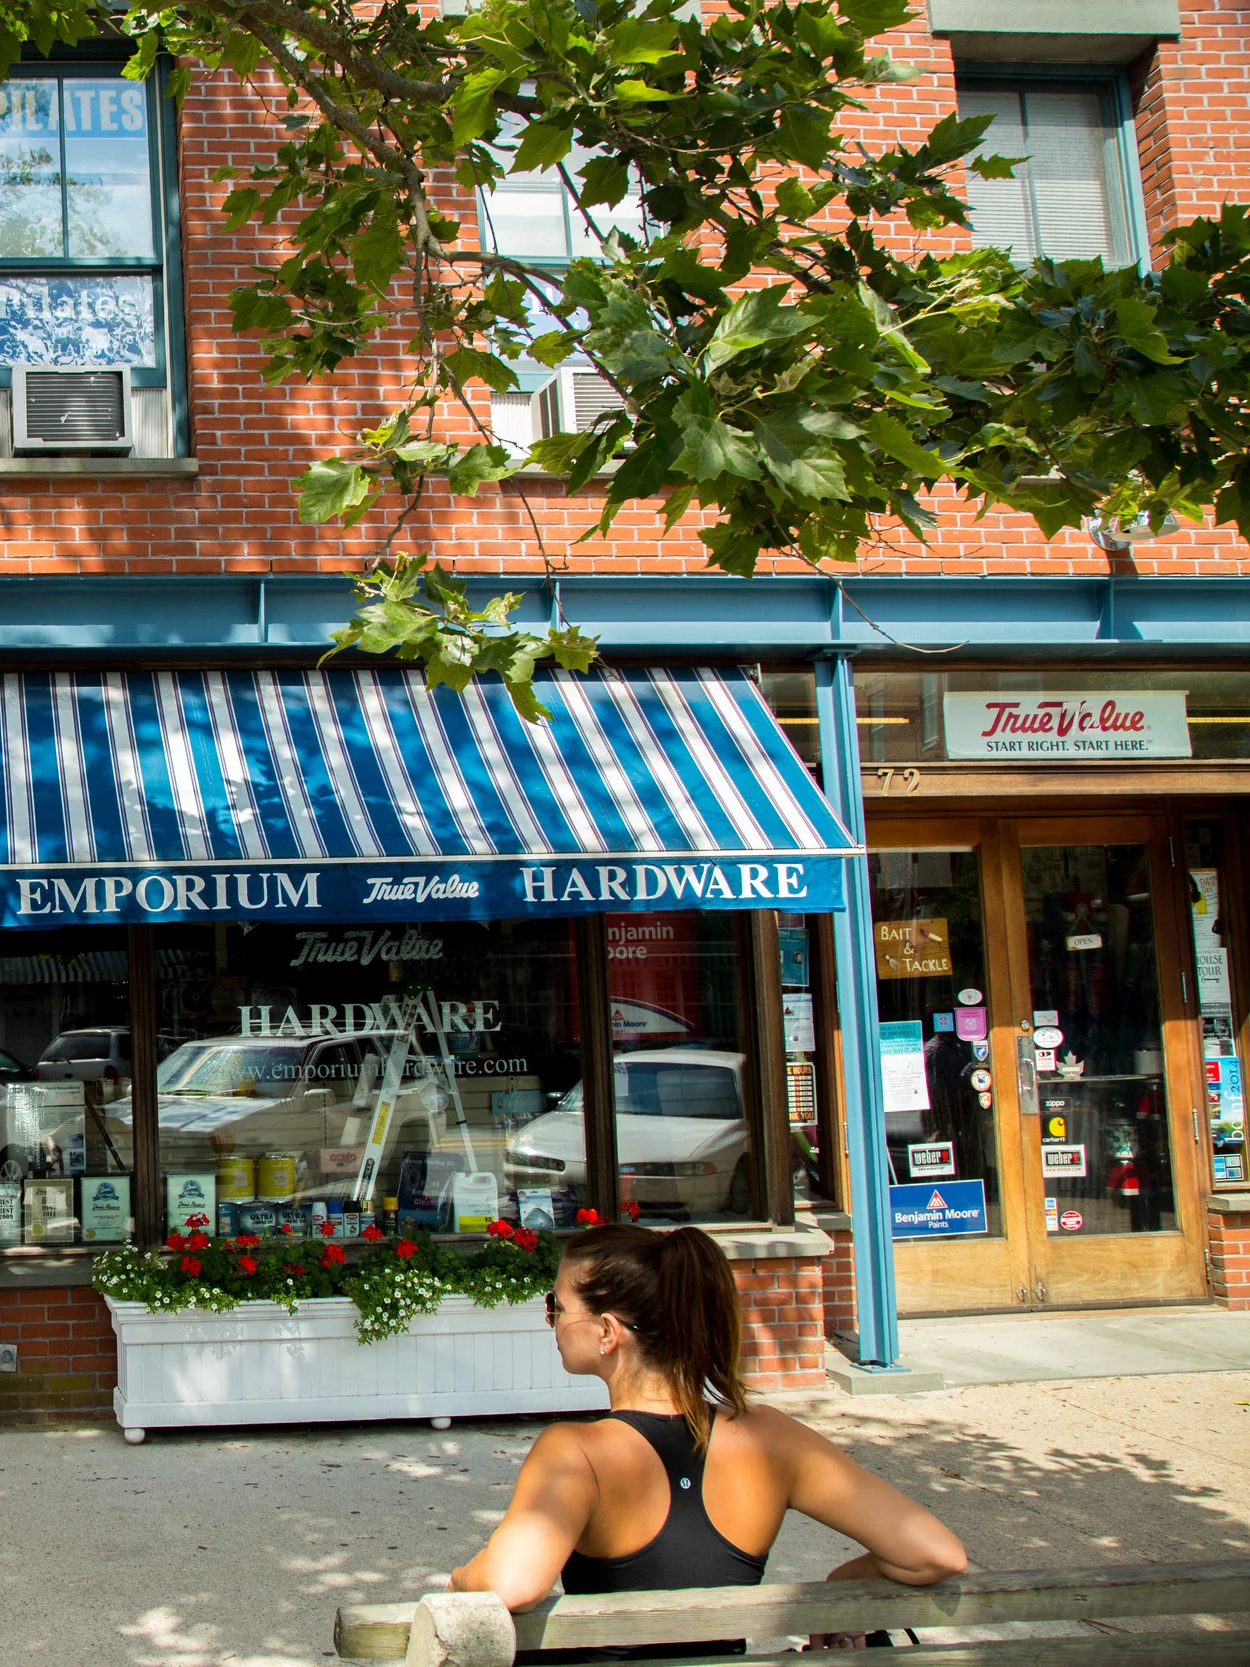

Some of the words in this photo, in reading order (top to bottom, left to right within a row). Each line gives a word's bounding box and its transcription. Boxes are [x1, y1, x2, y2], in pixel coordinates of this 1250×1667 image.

[986, 740, 1023, 752] START
[1027, 740, 1070, 752] RIGHT.
[1074, 739, 1111, 751] START
[1114, 738, 1149, 751] HERE.
[876, 767, 921, 797] 72
[16, 872, 322, 915] EMPORIUM
[519, 863, 809, 902] HARDWARE
[607, 921, 675, 945] njamin
[902, 942, 915, 955] &
[1073, 937, 1094, 946] OPEN
[607, 945, 648, 960] oore
[901, 958, 949, 972] TACKLE
[1197, 966, 1222, 976] TOUR
[237, 999, 502, 1039] HARDWARE
[224, 1055, 529, 1083] ww.emporiumhardware.com
[1228, 1059, 1240, 1093] 2014
[913, 1149, 941, 1165] weber
[1047, 1151, 1072, 1165] weber
[894, 1209, 943, 1225] Benjamin
[945, 1208, 979, 1220] Moore
[928, 1220, 948, 1229] Paints
